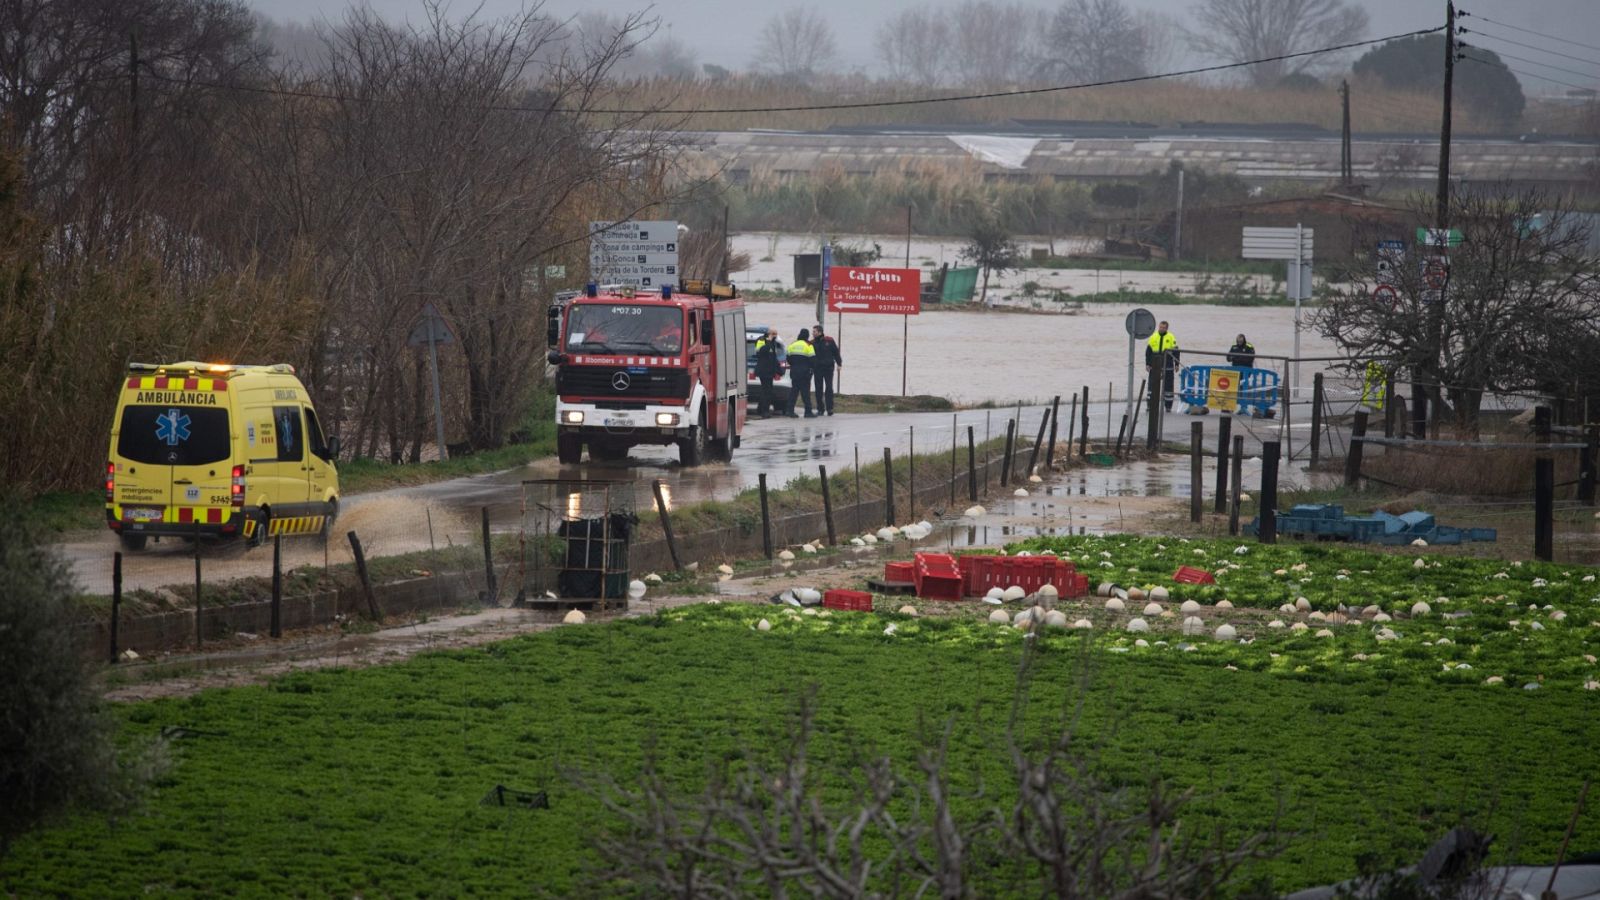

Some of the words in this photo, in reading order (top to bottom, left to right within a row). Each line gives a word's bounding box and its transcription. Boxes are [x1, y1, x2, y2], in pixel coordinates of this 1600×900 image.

[849, 270, 901, 285] Capfun
[845, 293, 905, 302] Tordera-Nacions
[136, 390, 217, 405] AMBULÀNCIA
